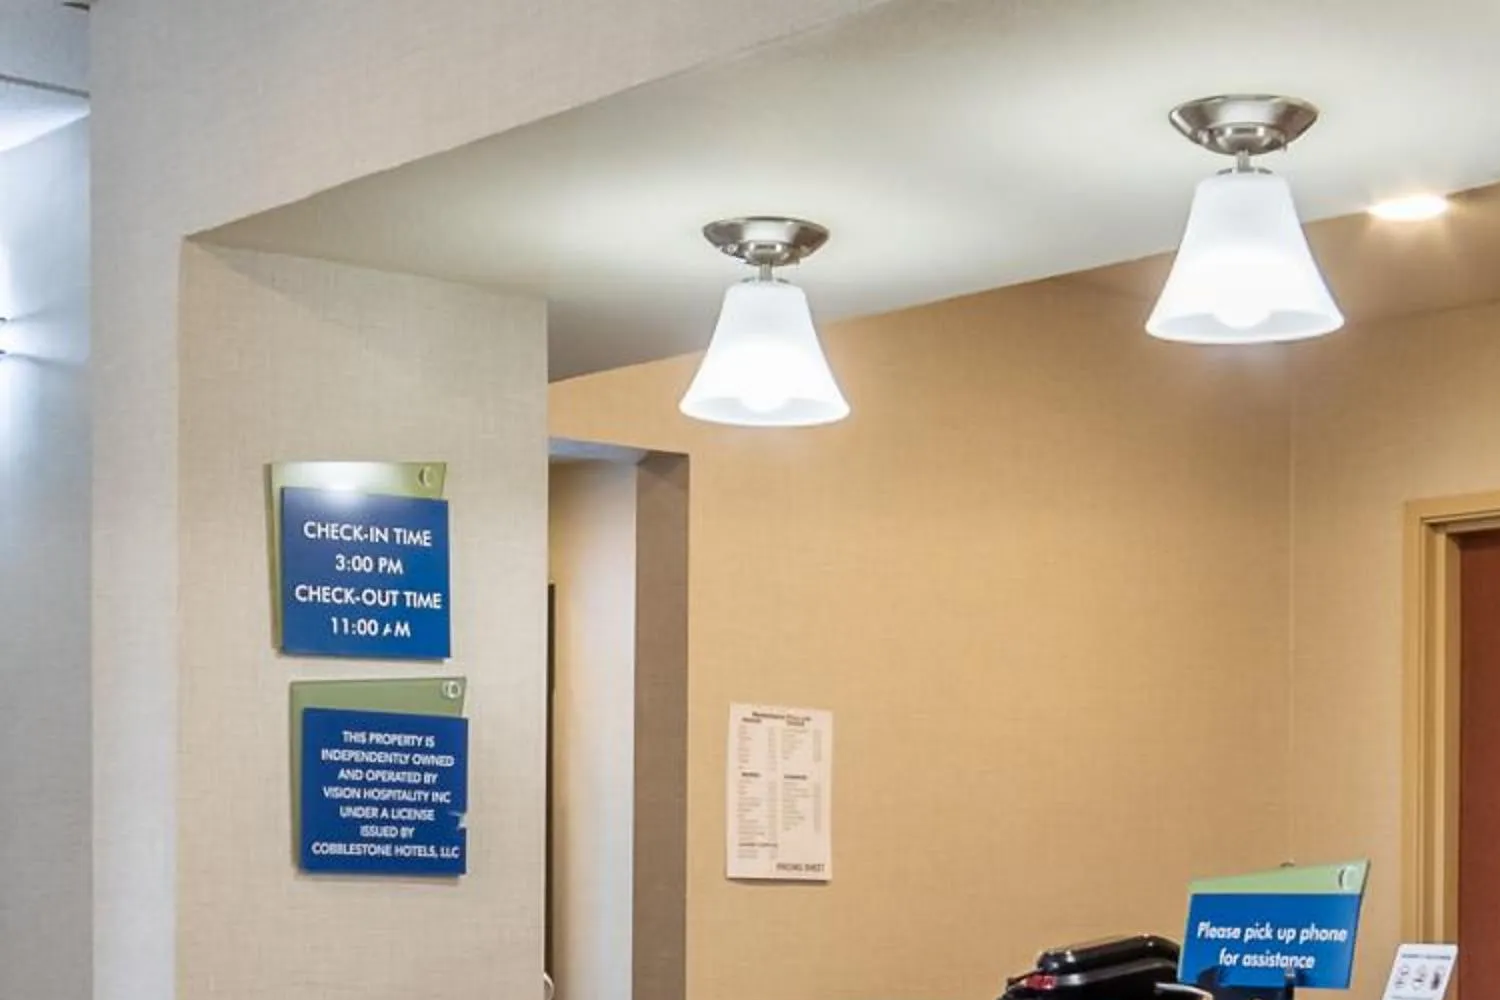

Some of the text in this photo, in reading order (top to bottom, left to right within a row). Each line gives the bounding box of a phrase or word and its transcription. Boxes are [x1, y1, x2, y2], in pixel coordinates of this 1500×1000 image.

[303, 521, 432, 547] CHECK-IN TIME
[335, 554, 403, 575] 3:00 PM
[295, 584, 442, 609] CHECK-OUT TIME
[330, 617, 379, 636] 11:00
[344, 731, 435, 747] THIS PROPERTY IS
[321, 749, 455, 767] INDEPENDENTLY OWNED
[338, 769, 439, 784] AND OPERATED BY
[323, 786, 451, 803] VISION HOSPITALITY INC
[339, 806, 436, 821] UNDER A LICENSE
[360, 825, 415, 838] ISSUED BY
[311, 842, 392, 857] COBBLESTONE
[440, 847, 460, 859] LLC
[1197, 921, 1349, 944] Please pick up phone
[1219, 947, 1315, 968] for assistance
